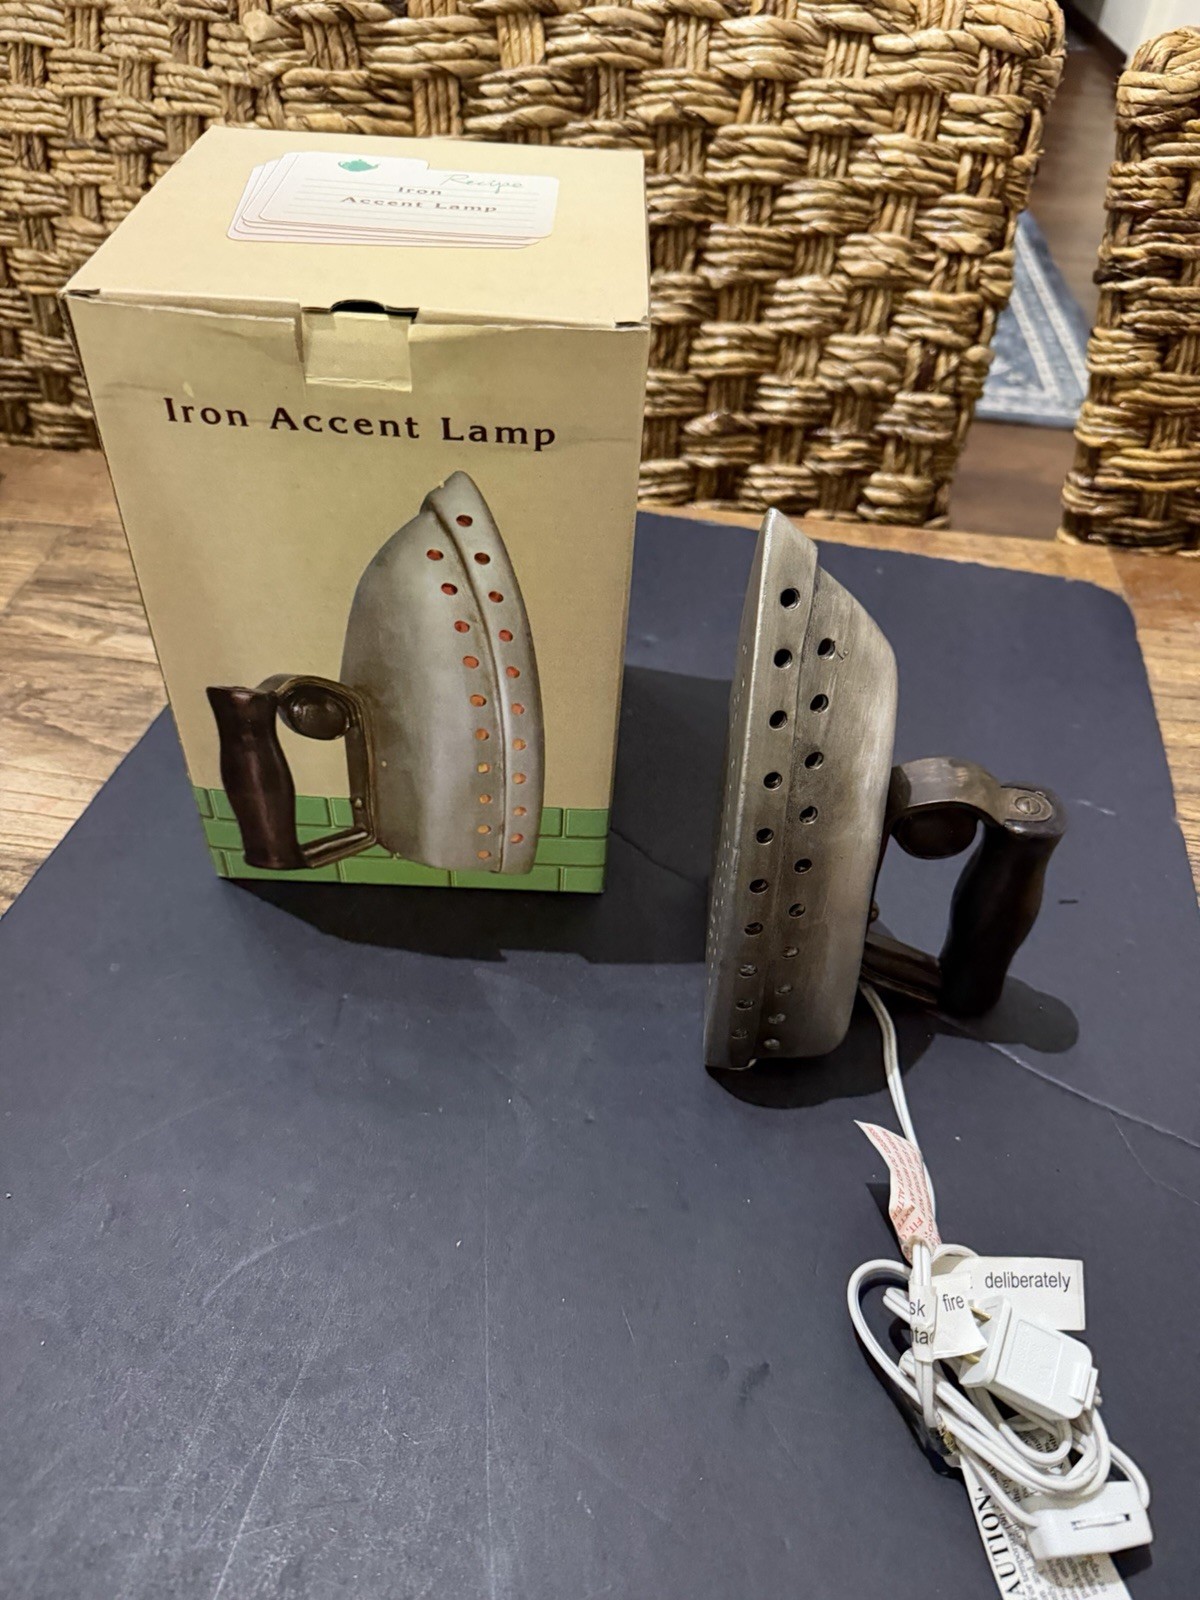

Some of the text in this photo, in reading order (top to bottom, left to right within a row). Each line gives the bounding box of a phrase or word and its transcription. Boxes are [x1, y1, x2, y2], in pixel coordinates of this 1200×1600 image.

[398, 186, 442, 196] Iron
[440, 173, 523, 194] Recipe
[340, 195, 497, 213] Accent Lamp
[163, 397, 556, 451] Iron Accent Lamp
[985, 1271, 1071, 1293] deliberately
[942, 1293, 965, 1312] fire
